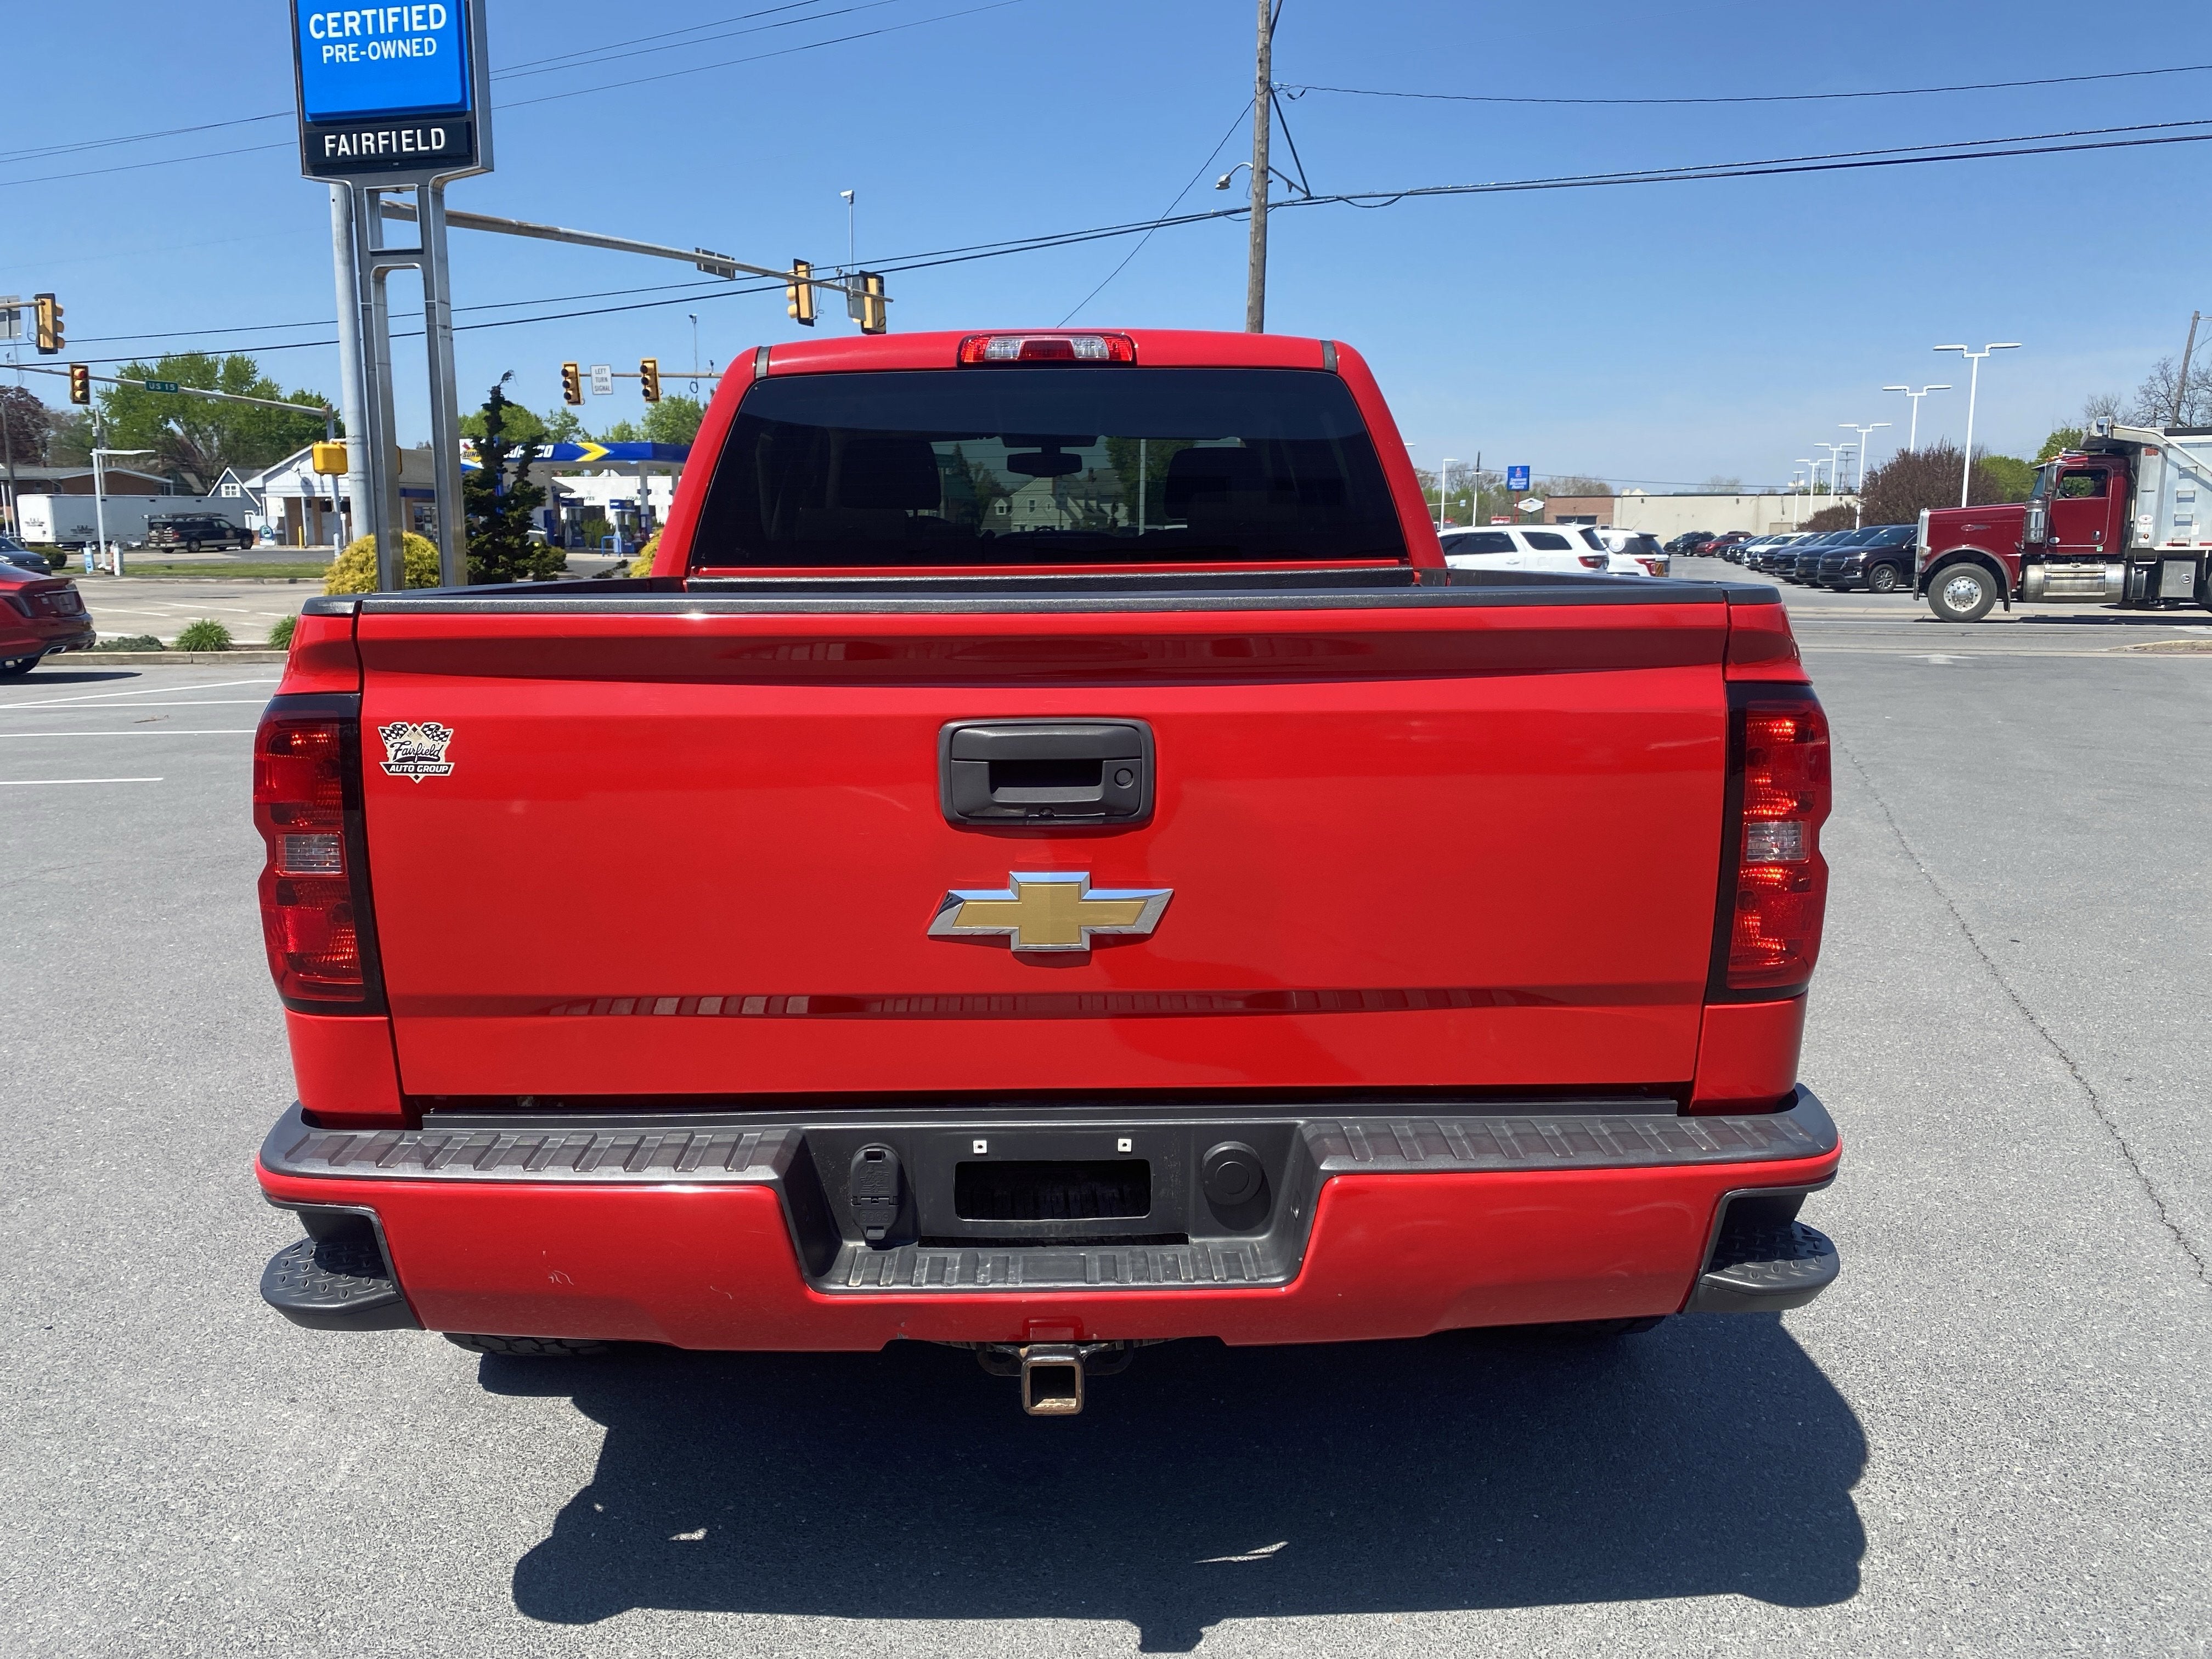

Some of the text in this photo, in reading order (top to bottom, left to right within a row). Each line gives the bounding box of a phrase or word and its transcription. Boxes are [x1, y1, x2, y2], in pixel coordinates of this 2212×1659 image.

[309, 3, 447, 40] CERTIFIED
[322, 37, 437, 64] PRE-OWNED
[324, 128, 445, 157] FAIRFIELD
[390, 741, 444, 761] Fairfield
